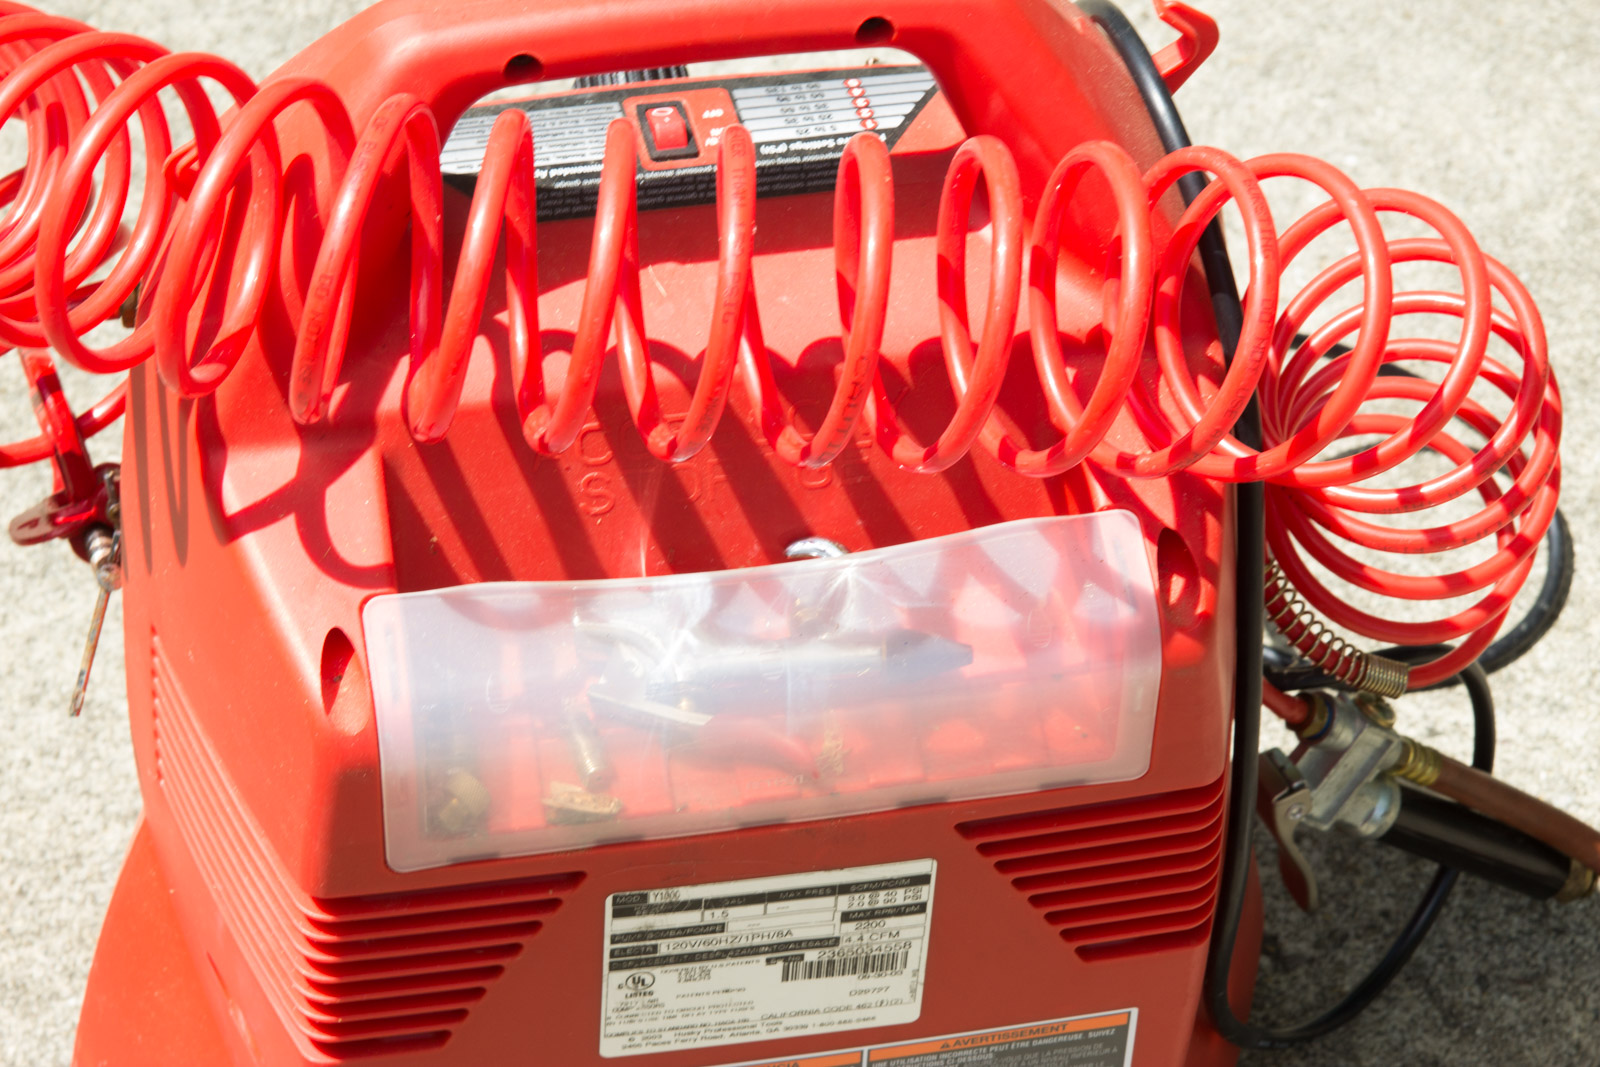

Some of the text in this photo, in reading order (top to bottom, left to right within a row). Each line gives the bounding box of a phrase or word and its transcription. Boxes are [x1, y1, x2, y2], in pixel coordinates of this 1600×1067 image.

[904, 886, 924, 895] PSI
[903, 893, 923, 901] PSI
[710, 910, 729, 919] 1.5
[855, 919, 887, 930] 2200
[869, 930, 901, 940] CFM
[761, 1007, 821, 1020] CALIFORNIA
[824, 1003, 851, 1013] CODE
[674, 1029, 702, 1038] Husky
[704, 1023, 758, 1033] Professional
[952, 1021, 1068, 1049] AVERTISSEMENT
[938, 1046, 988, 1061] INCORRECTE
[989, 1043, 1009, 1053] PEUT
[1087, 1027, 1115, 1038] SUIVEZ
